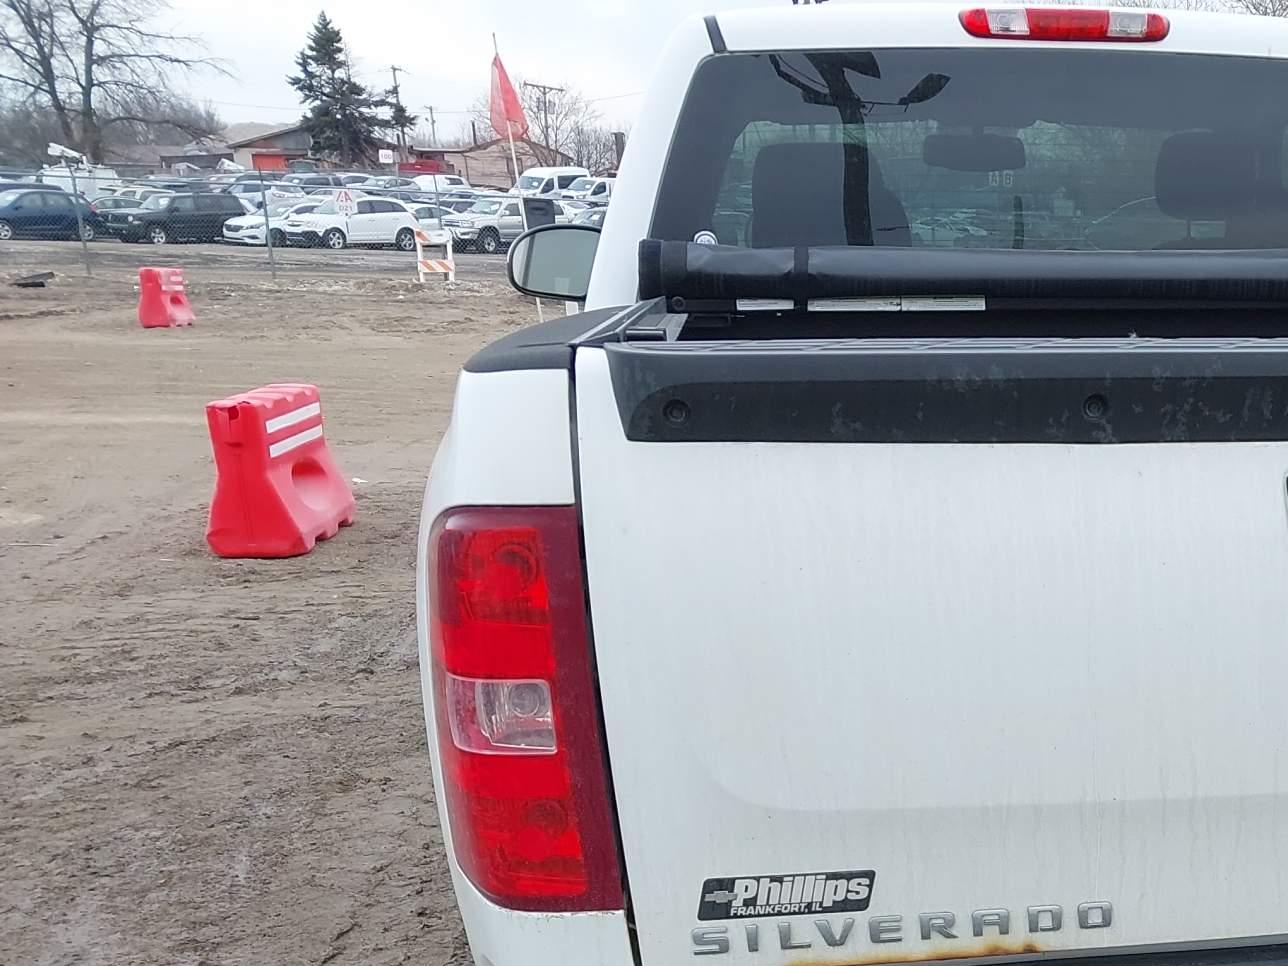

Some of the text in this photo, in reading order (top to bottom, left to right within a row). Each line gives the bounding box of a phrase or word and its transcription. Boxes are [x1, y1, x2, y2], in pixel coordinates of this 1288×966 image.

[731, 875, 870, 907] Phillips
[730, 901, 823, 917] FRANKFORT, IL
[691, 901, 1112, 954] SILVERADO
